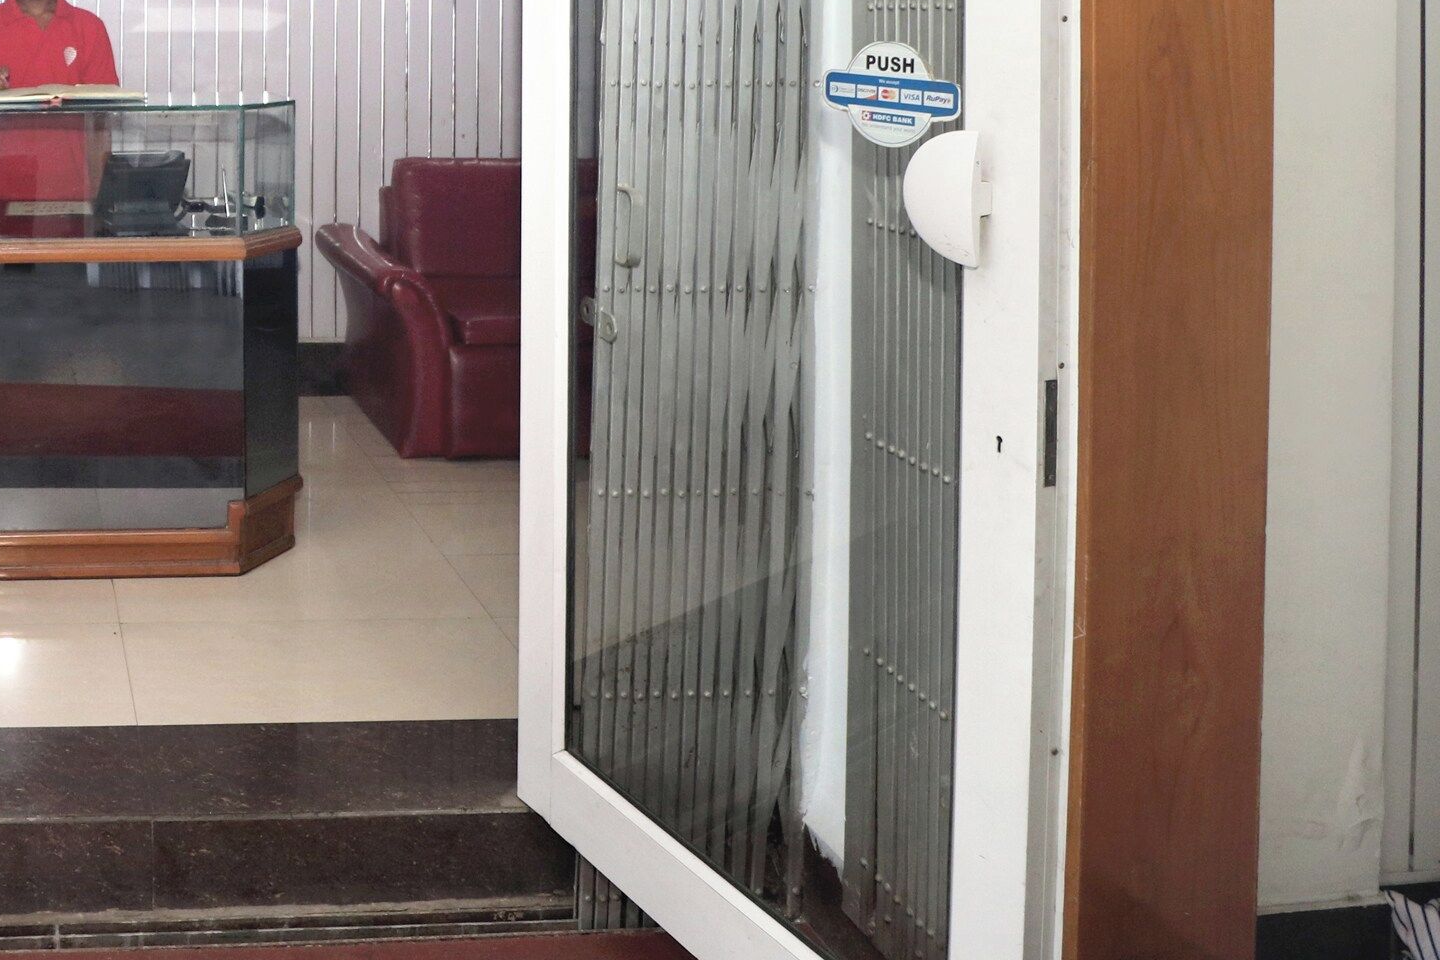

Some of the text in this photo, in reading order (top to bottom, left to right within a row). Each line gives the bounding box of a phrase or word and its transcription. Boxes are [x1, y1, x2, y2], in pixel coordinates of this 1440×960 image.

[866, 55, 915, 74] PUSH
[903, 93, 920, 102] VISA
[925, 95, 948, 105] RuPay
[872, 114, 913, 125] HDFC BANK
